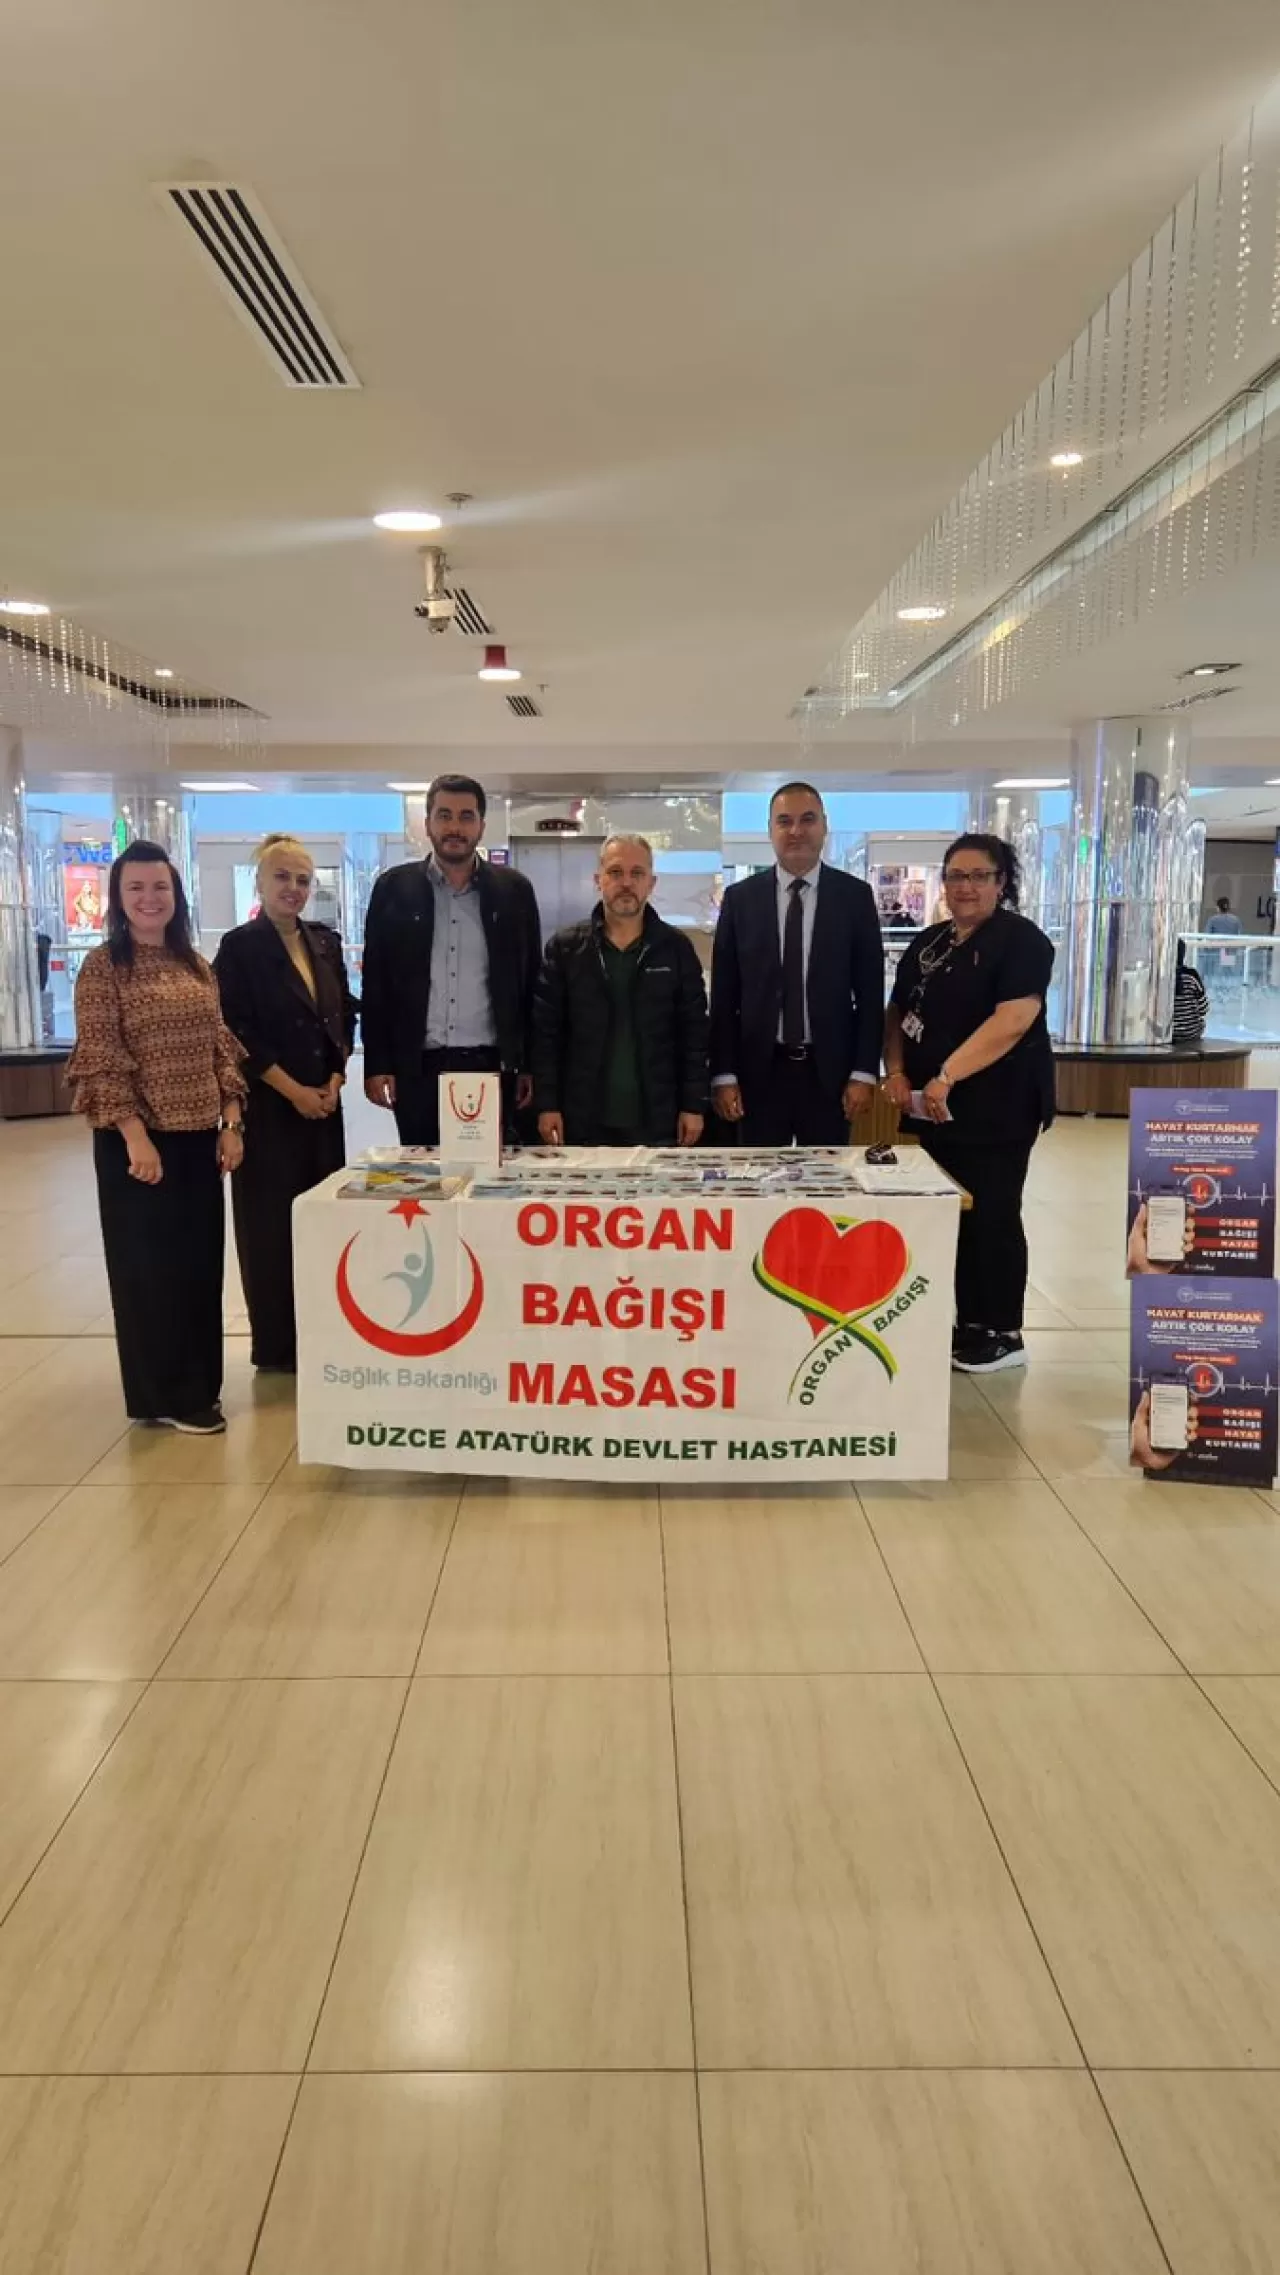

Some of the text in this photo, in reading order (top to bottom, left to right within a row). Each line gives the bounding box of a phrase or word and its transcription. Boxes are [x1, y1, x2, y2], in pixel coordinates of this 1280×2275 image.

[1144, 1121, 1259, 1133] HAYAT KURTARMAK
[1214, 1135, 1253, 1145] KOLAY
[518, 1203, 732, 1250] ORGAN
[522, 1276, 724, 1341] BAĞIŞI
[1147, 1309, 1262, 1323] HAYAT KURTARMAK
[799, 1275, 930, 1406] ORGAN BAĞIŞI
[1217, 1323, 1256, 1334] KOLAY
[323, 1363, 498, 1396] Sağlık Bakanlığı
[509, 1362, 735, 1408] MASASI
[347, 1421, 896, 1460] DÜZCE ATATÜRK DEVLET HASTANESİ
